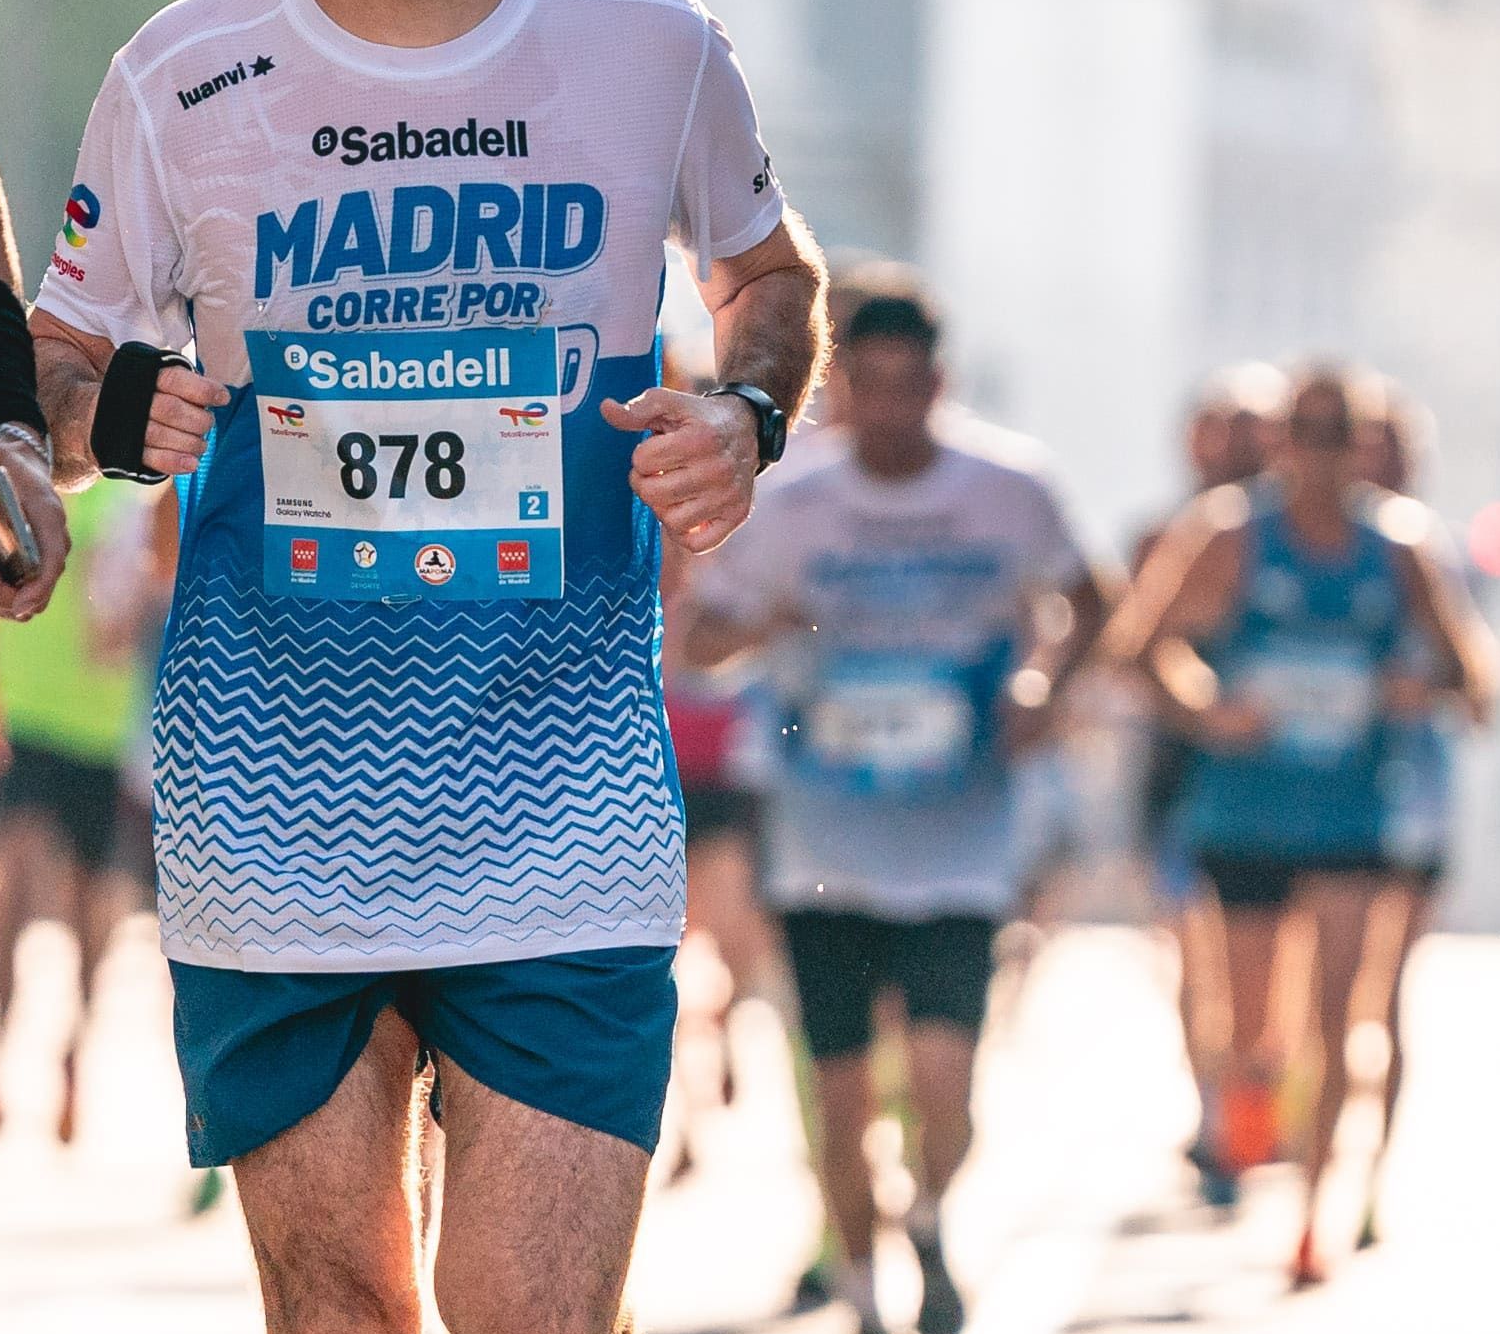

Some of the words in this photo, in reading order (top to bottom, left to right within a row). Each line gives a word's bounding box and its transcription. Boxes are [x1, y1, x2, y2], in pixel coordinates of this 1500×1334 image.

[177, 61, 247, 110] luanvi
[341, 119, 528, 165] Sabadell
[255, 183, 604, 299] MADRID
[307, 284, 449, 329] CORRE
[457, 282, 540, 318] POR
[308, 348, 510, 390] Sabadell
[337, 431, 466, 500] 878
[527, 495, 540, 515] 2
